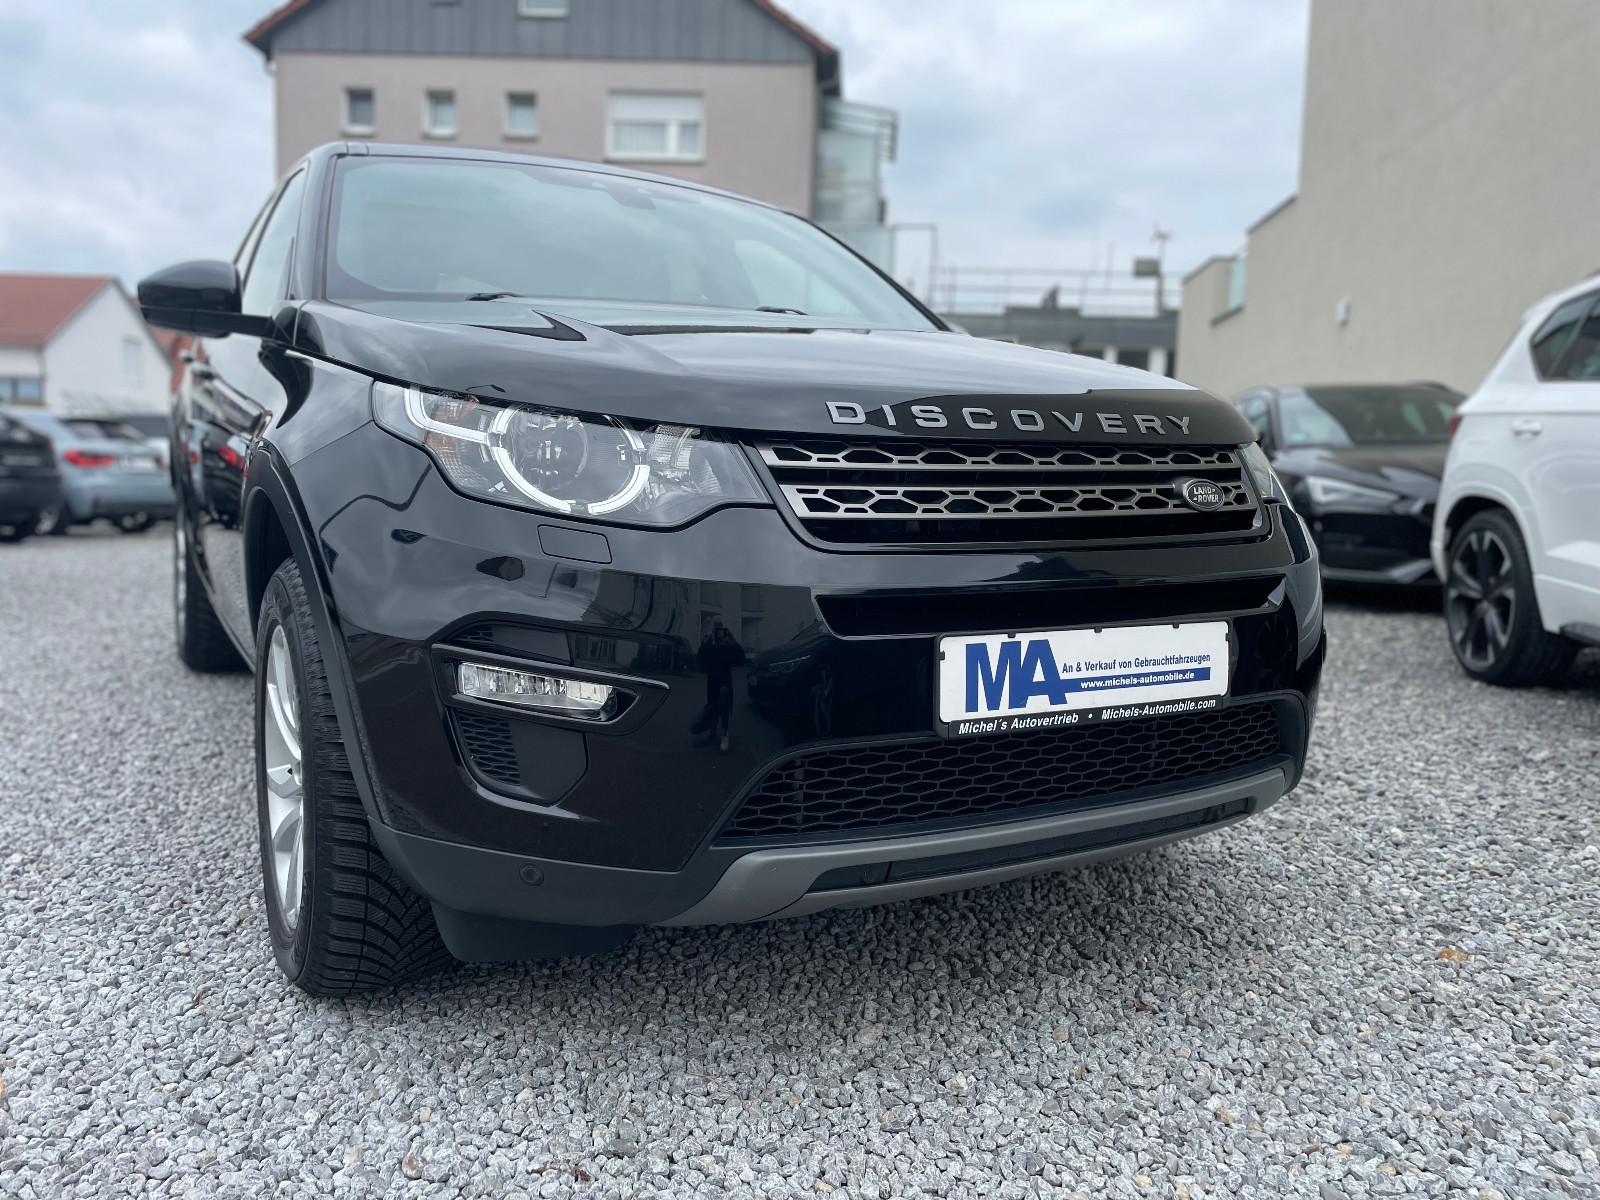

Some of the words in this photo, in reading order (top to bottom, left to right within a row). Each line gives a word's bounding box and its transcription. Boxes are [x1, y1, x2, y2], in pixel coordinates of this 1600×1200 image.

[826, 401, 1191, 436] DISCOVERY
[1193, 486, 1212, 495] LAND
[1197, 494, 1219, 503] ROVER
[1062, 662, 1074, 674] An
[1076, 661, 1082, 672] &
[1084, 659, 1116, 672] Verkauf
[1119, 660, 1132, 669] von
[1134, 653, 1211, 668] Gebrauchtfahrzeugen
[965, 639, 1068, 713] MA
[1080, 671, 1195, 689] www.michels-automobile.de
[1010, 712, 1079, 729] Autovertrieb
[1101, 699, 1216, 720] Michels-Automobile.com
